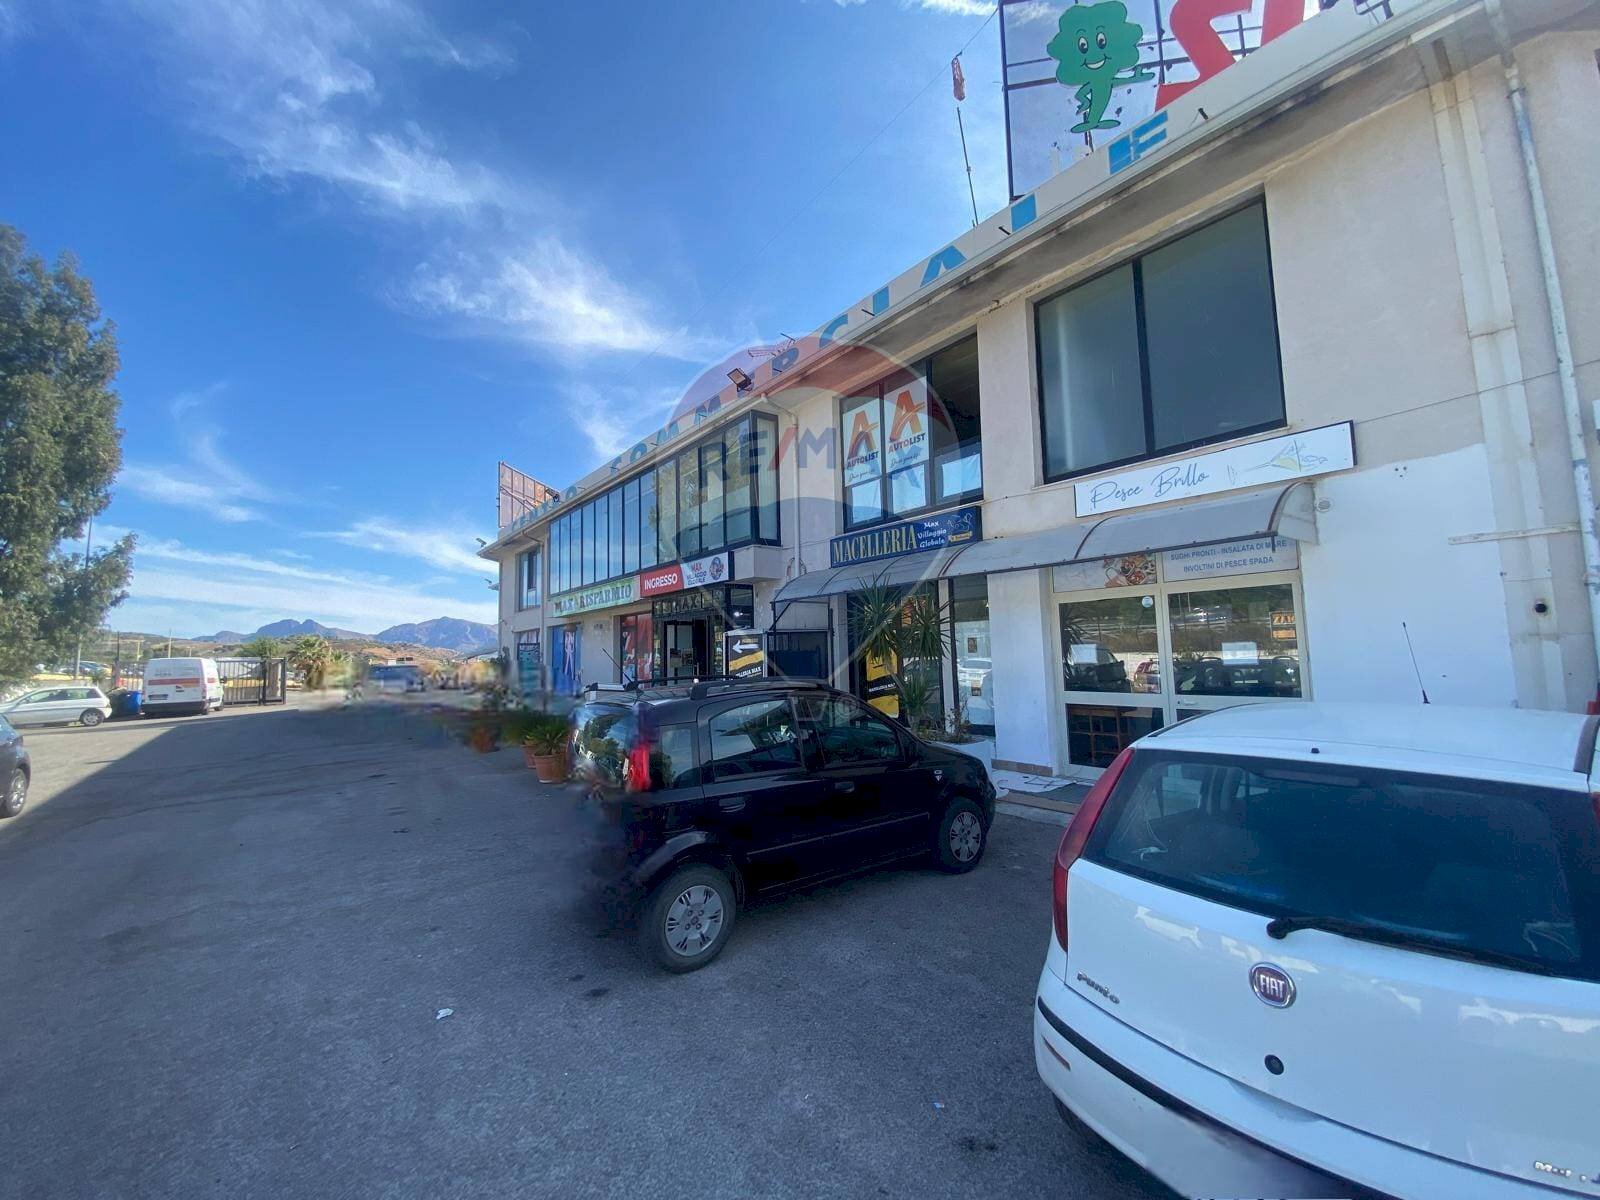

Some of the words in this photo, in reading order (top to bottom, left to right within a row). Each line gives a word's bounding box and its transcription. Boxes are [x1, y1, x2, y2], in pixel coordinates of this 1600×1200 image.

[888, 433, 926, 454] AUTOLIST
[846, 451, 880, 470] AUTOLIST
[1089, 481, 1144, 509] Pesce
[1149, 462, 1210, 498] Brillo
[916, 528, 947, 540] Villaggio
[923, 520, 940, 529] Max
[832, 524, 918, 564] MACELLERIA
[919, 539, 946, 548] Globale
[1191, 549, 1217, 559] PRONTI
[1221, 543, 1255, 555] INSALATA
[1255, 541, 1264, 551] DI
[1183, 562, 1215, 573] INVOLTINI
[1215, 561, 1224, 570] DI
[1223, 559, 1248, 570] PESCE
[1248, 556, 1274, 567] SPADA
[643, 572, 678, 591] INGRESSO
[579, 583, 632, 609] RISPARMIO
[1076, 971, 1120, 1004] Punto
[1260, 974, 1286, 999] FIAT
